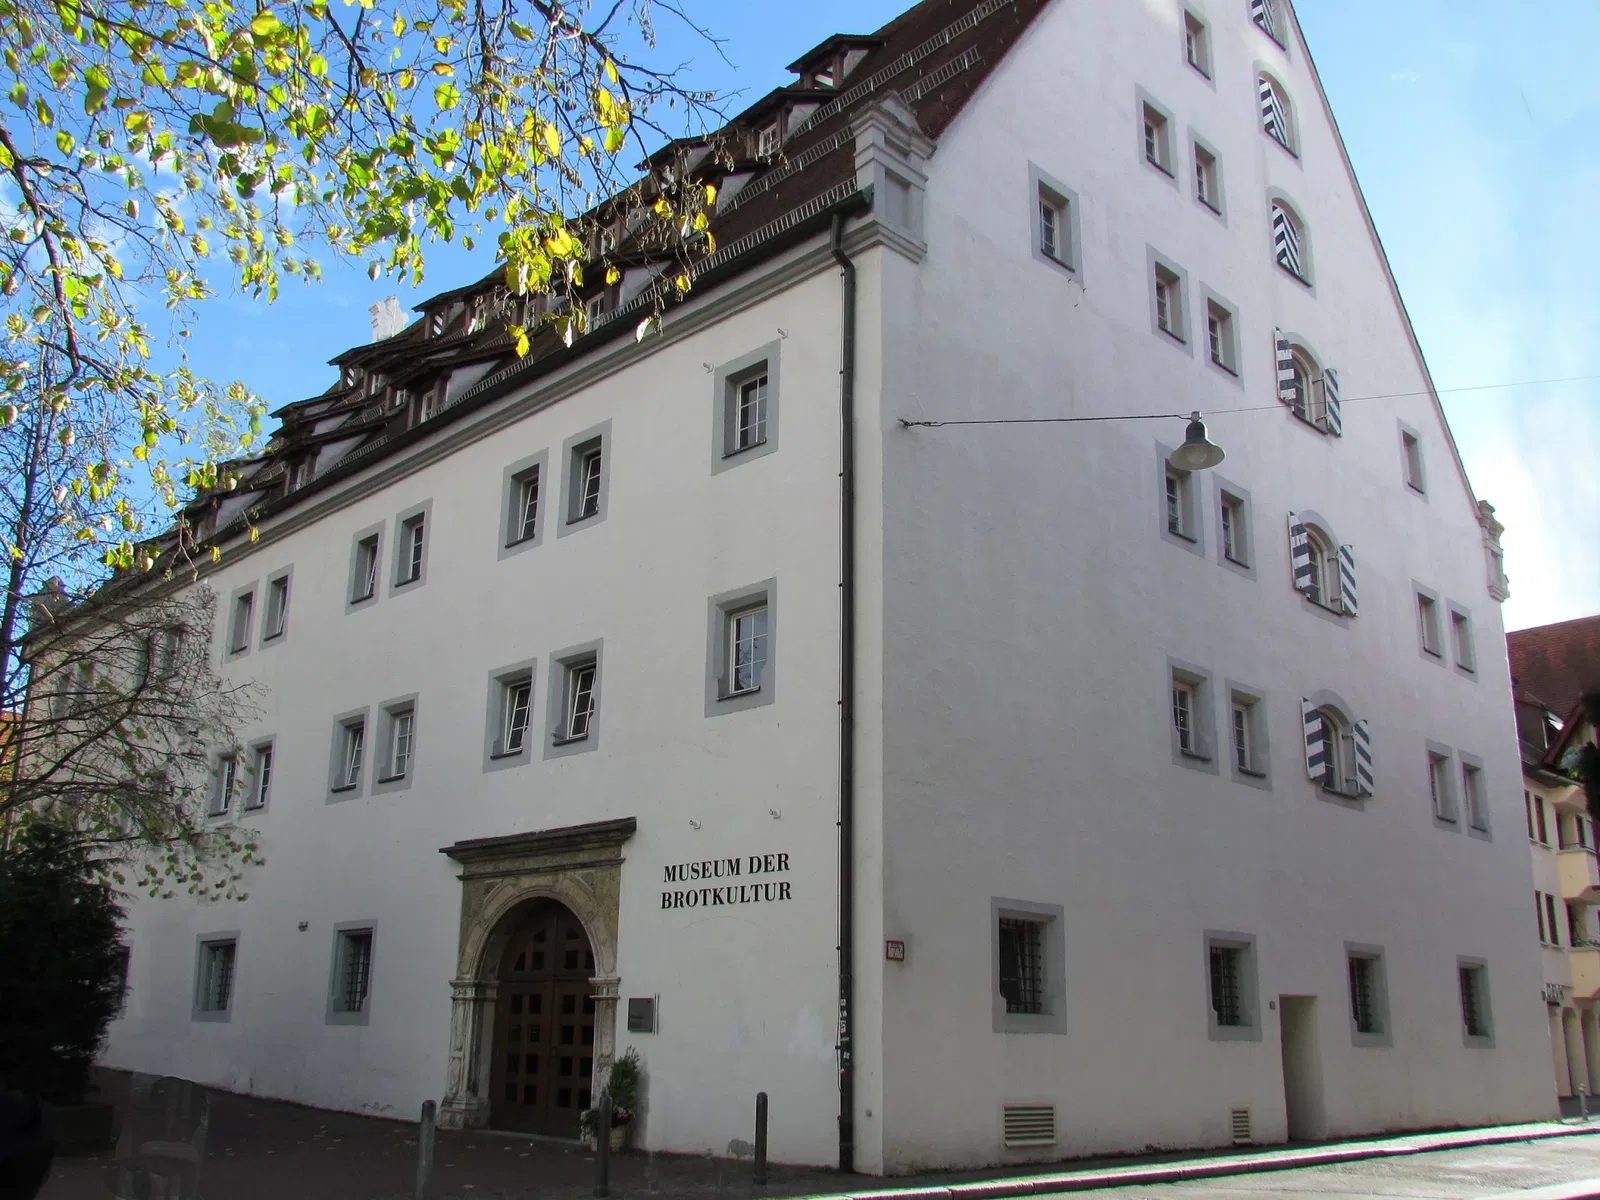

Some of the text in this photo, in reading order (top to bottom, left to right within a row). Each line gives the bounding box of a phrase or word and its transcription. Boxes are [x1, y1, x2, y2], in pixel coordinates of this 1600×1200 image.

[663, 852, 790, 883] MUSEUM DER
[660, 881, 792, 909] BROTKULTUR
